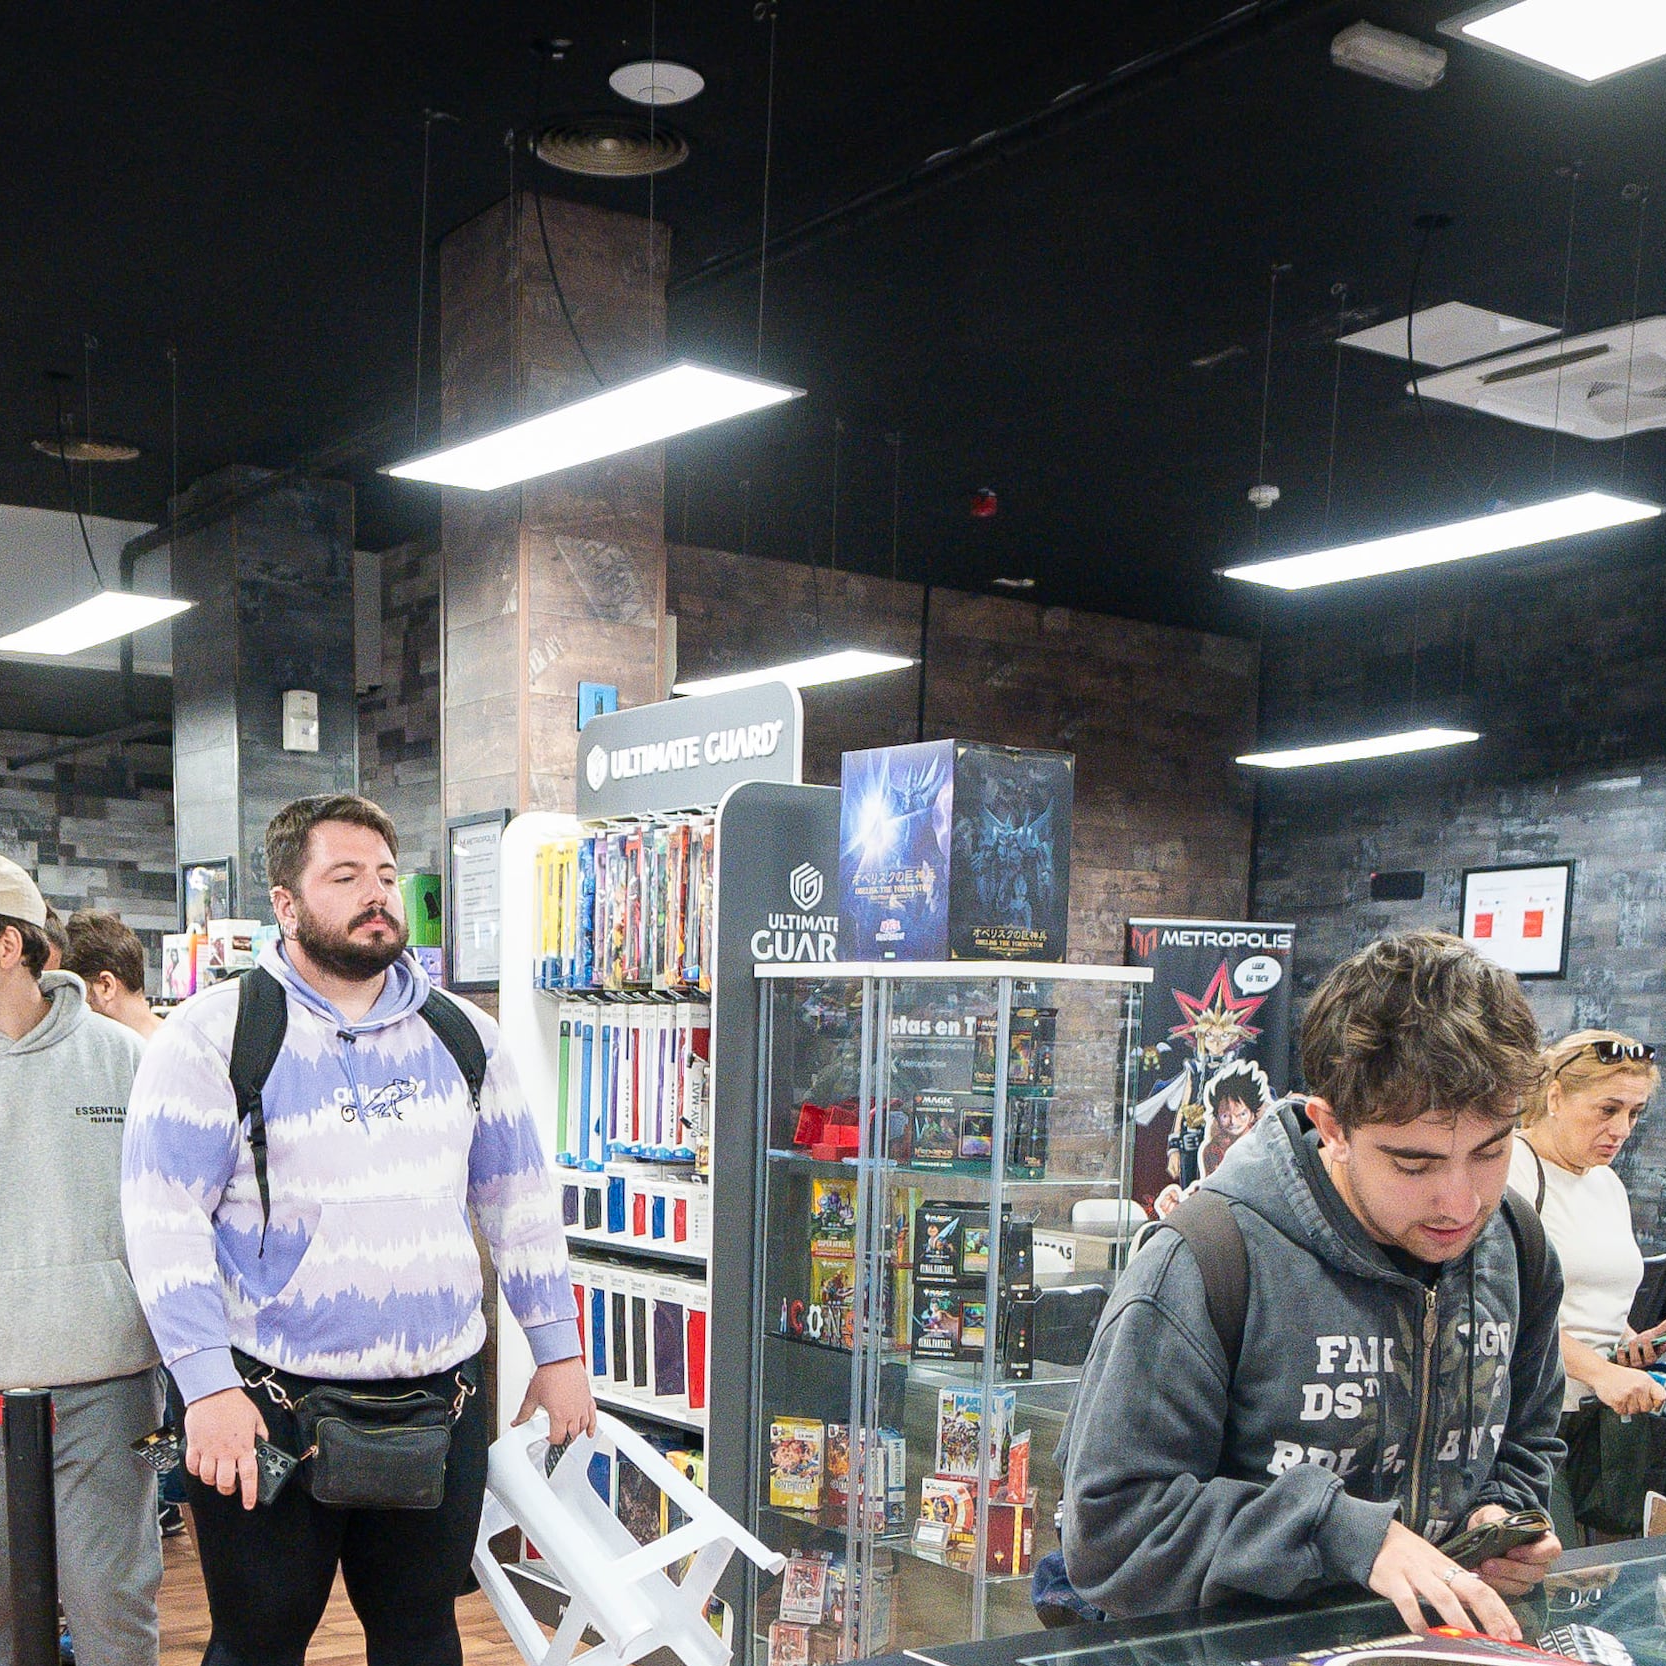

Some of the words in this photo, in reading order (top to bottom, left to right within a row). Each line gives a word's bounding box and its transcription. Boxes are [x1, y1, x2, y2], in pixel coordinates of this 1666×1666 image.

[610, 735, 701, 780] ULTIMATE
[768, 912, 840, 932] ULTIMATE
[750, 929, 838, 962] GUAR
[1160, 929, 1292, 949] METROPOLIS
[935, 1019, 961, 1036] en
[963, 1015, 977, 1036] T
[690, 1080, 701, 1139] PAY-MAT
[922, 1096, 954, 1105] MAGIC
[75, 1106, 128, 1117] ESSENTIAL
